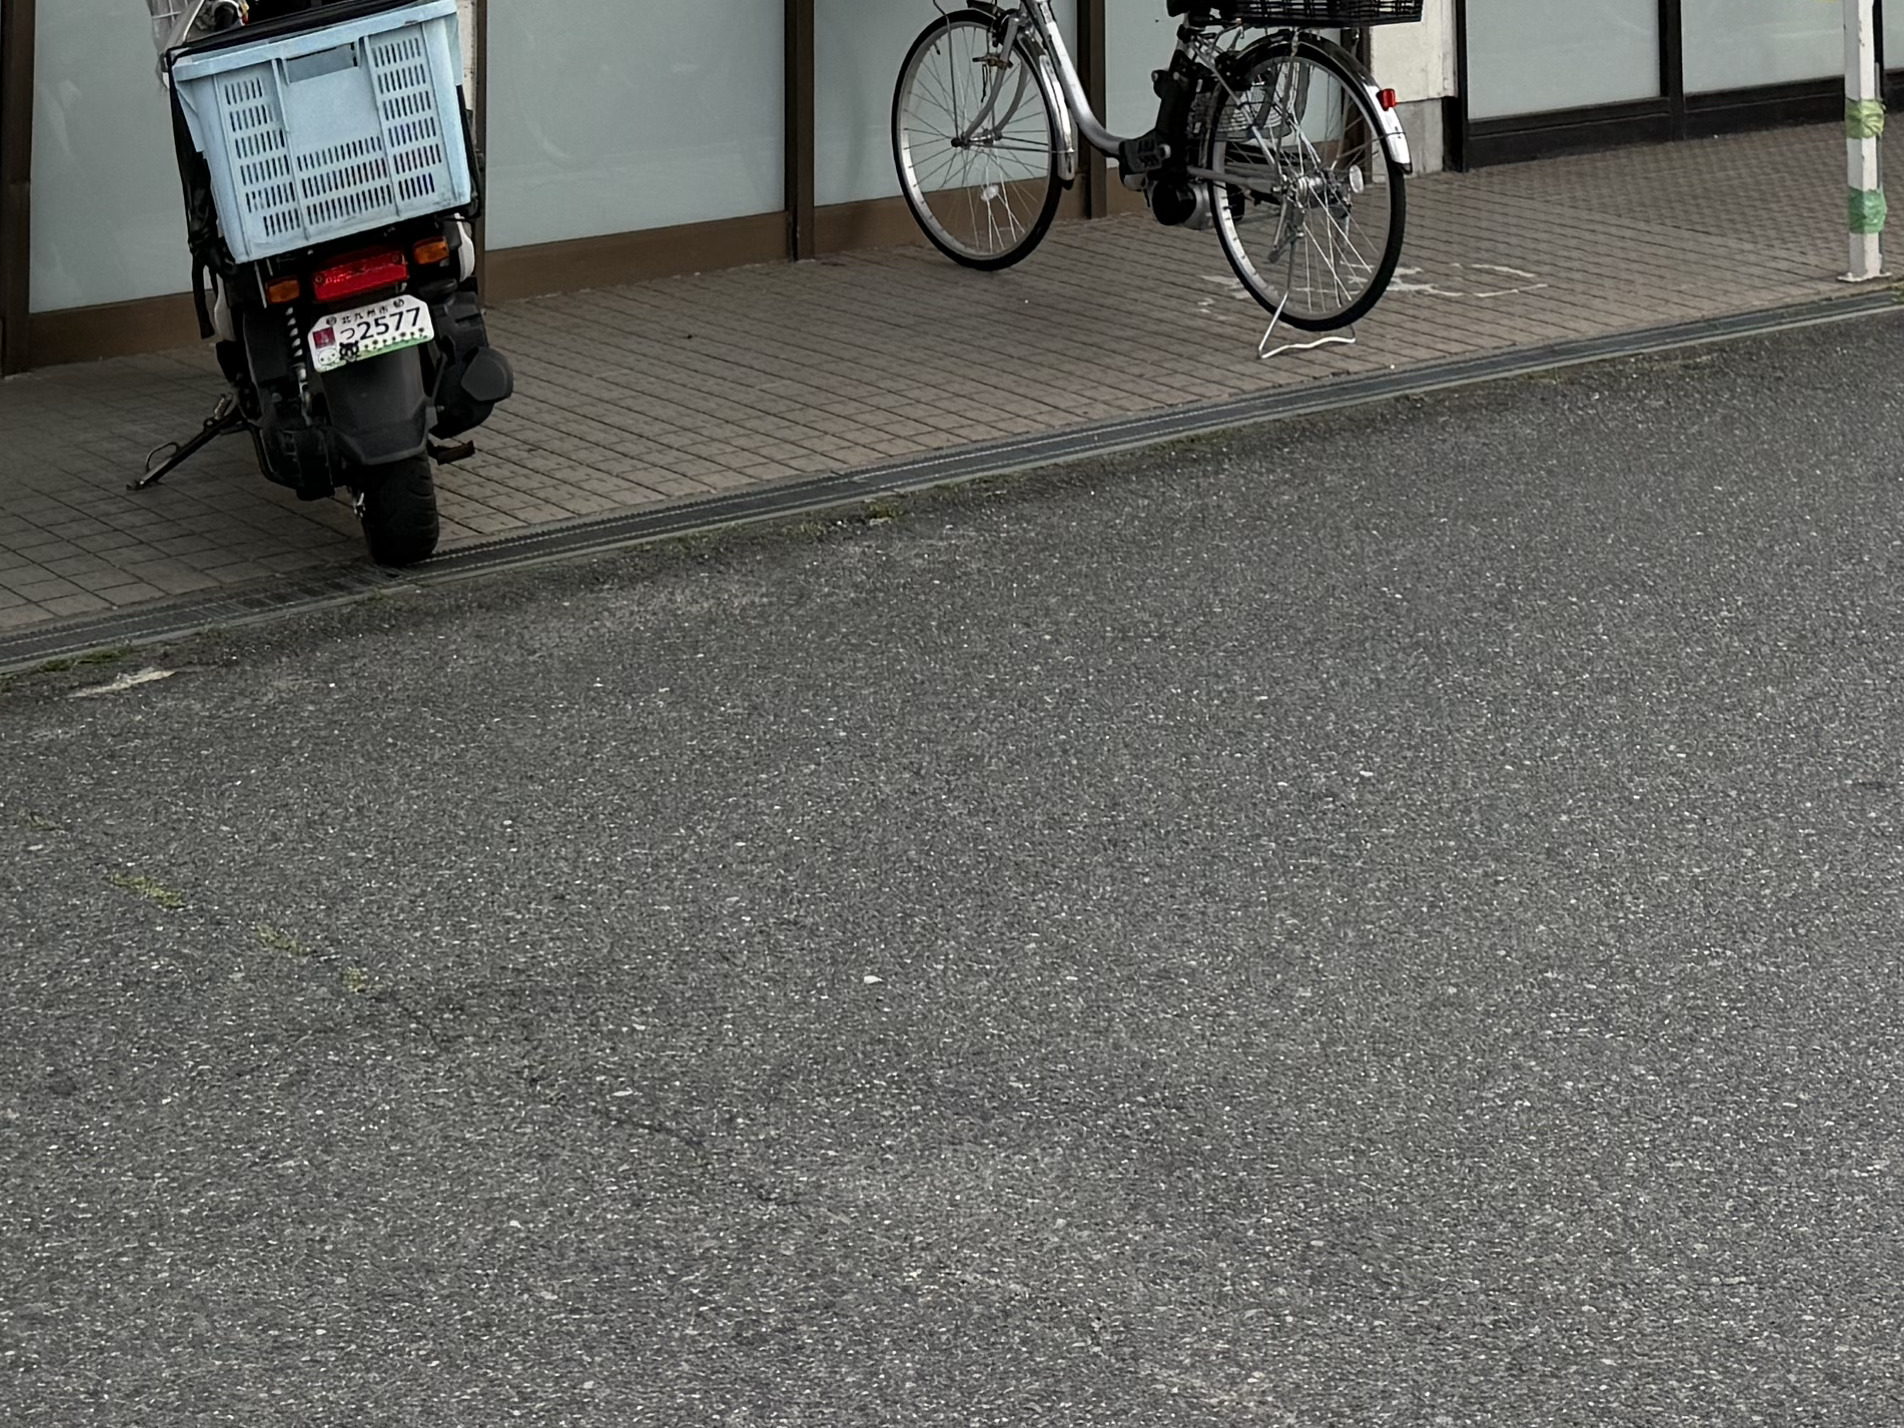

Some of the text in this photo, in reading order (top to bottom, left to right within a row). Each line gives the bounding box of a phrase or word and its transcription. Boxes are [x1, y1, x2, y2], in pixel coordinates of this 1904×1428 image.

[340, 307, 421, 341] つ 2577
[341, 305, 389, 325] 北九州市
